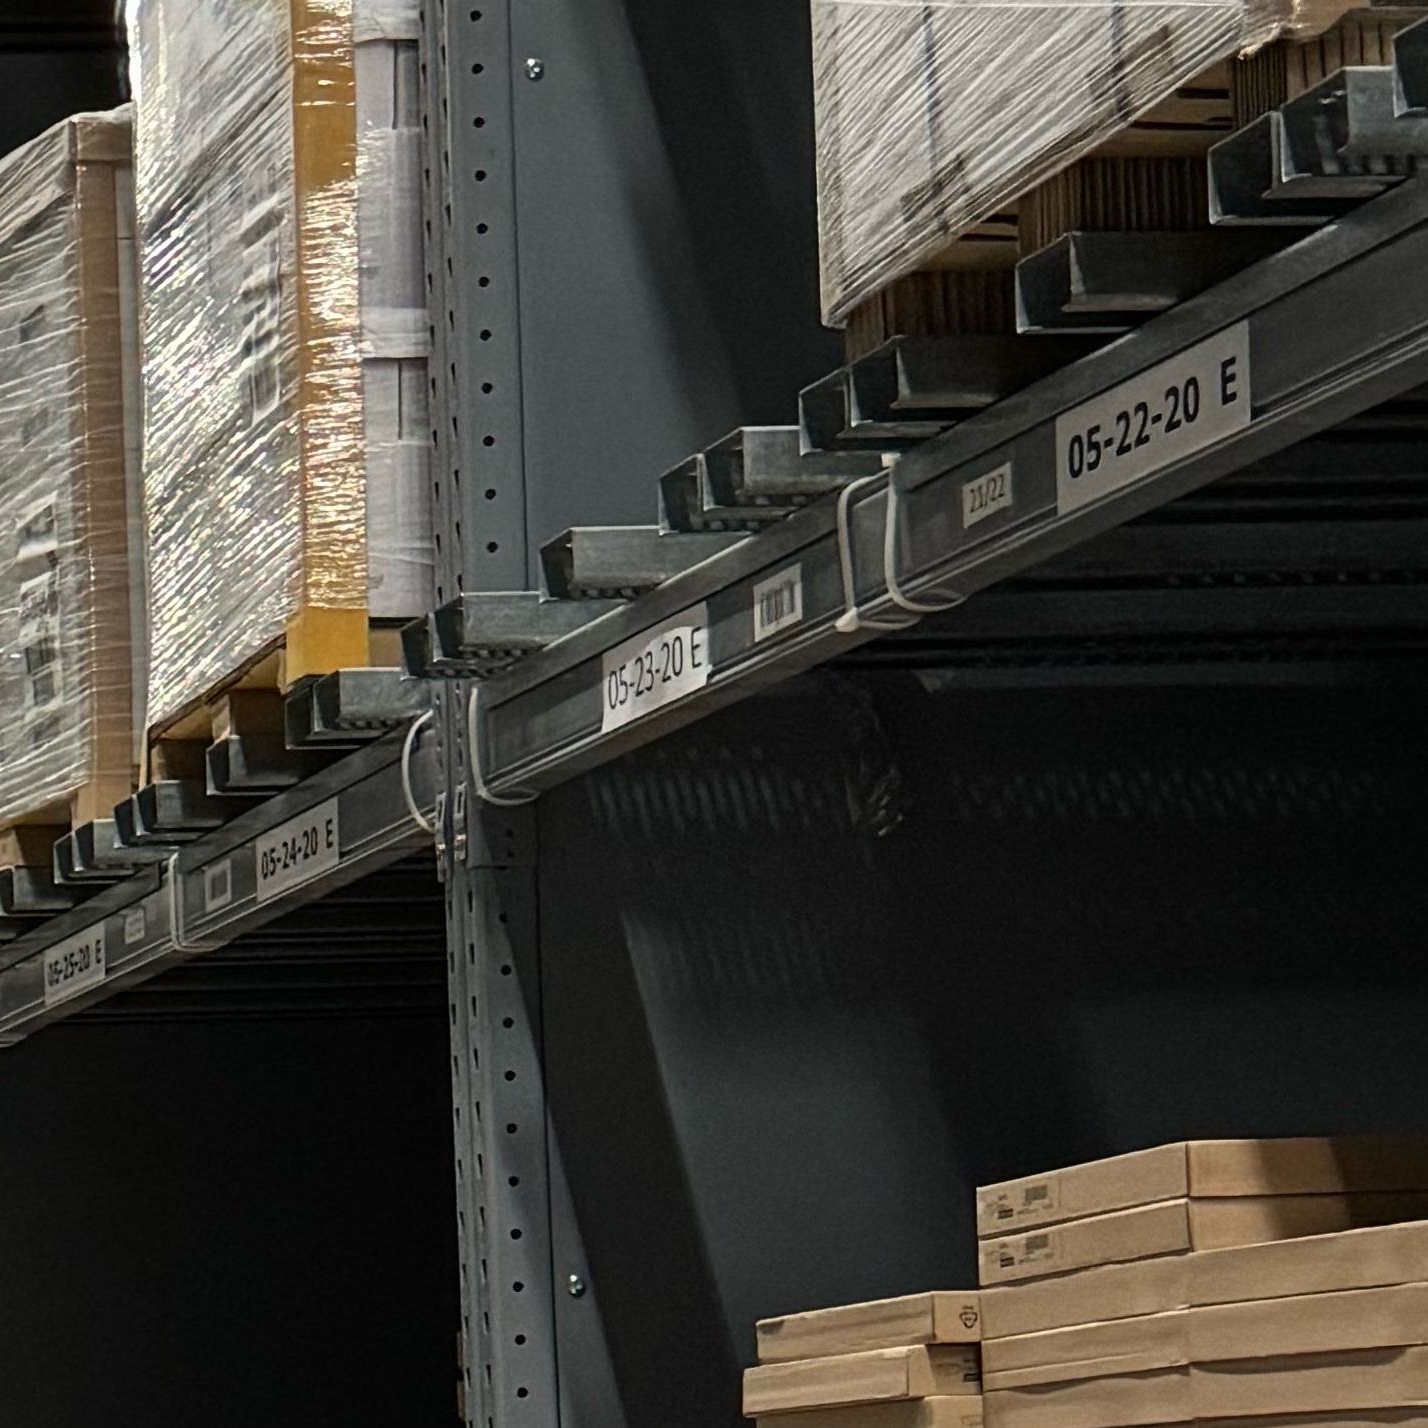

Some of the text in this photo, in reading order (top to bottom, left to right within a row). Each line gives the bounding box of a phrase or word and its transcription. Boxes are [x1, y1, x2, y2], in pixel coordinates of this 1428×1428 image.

[1067, 355, 1238, 480] 05-22-20 E
[968, 472, 1006, 514] 21/22
[607, 626, 703, 711] 05-23-20 E
[261, 817, 334, 881] 05-24-20 E
[95, 939, 102, 964] E
